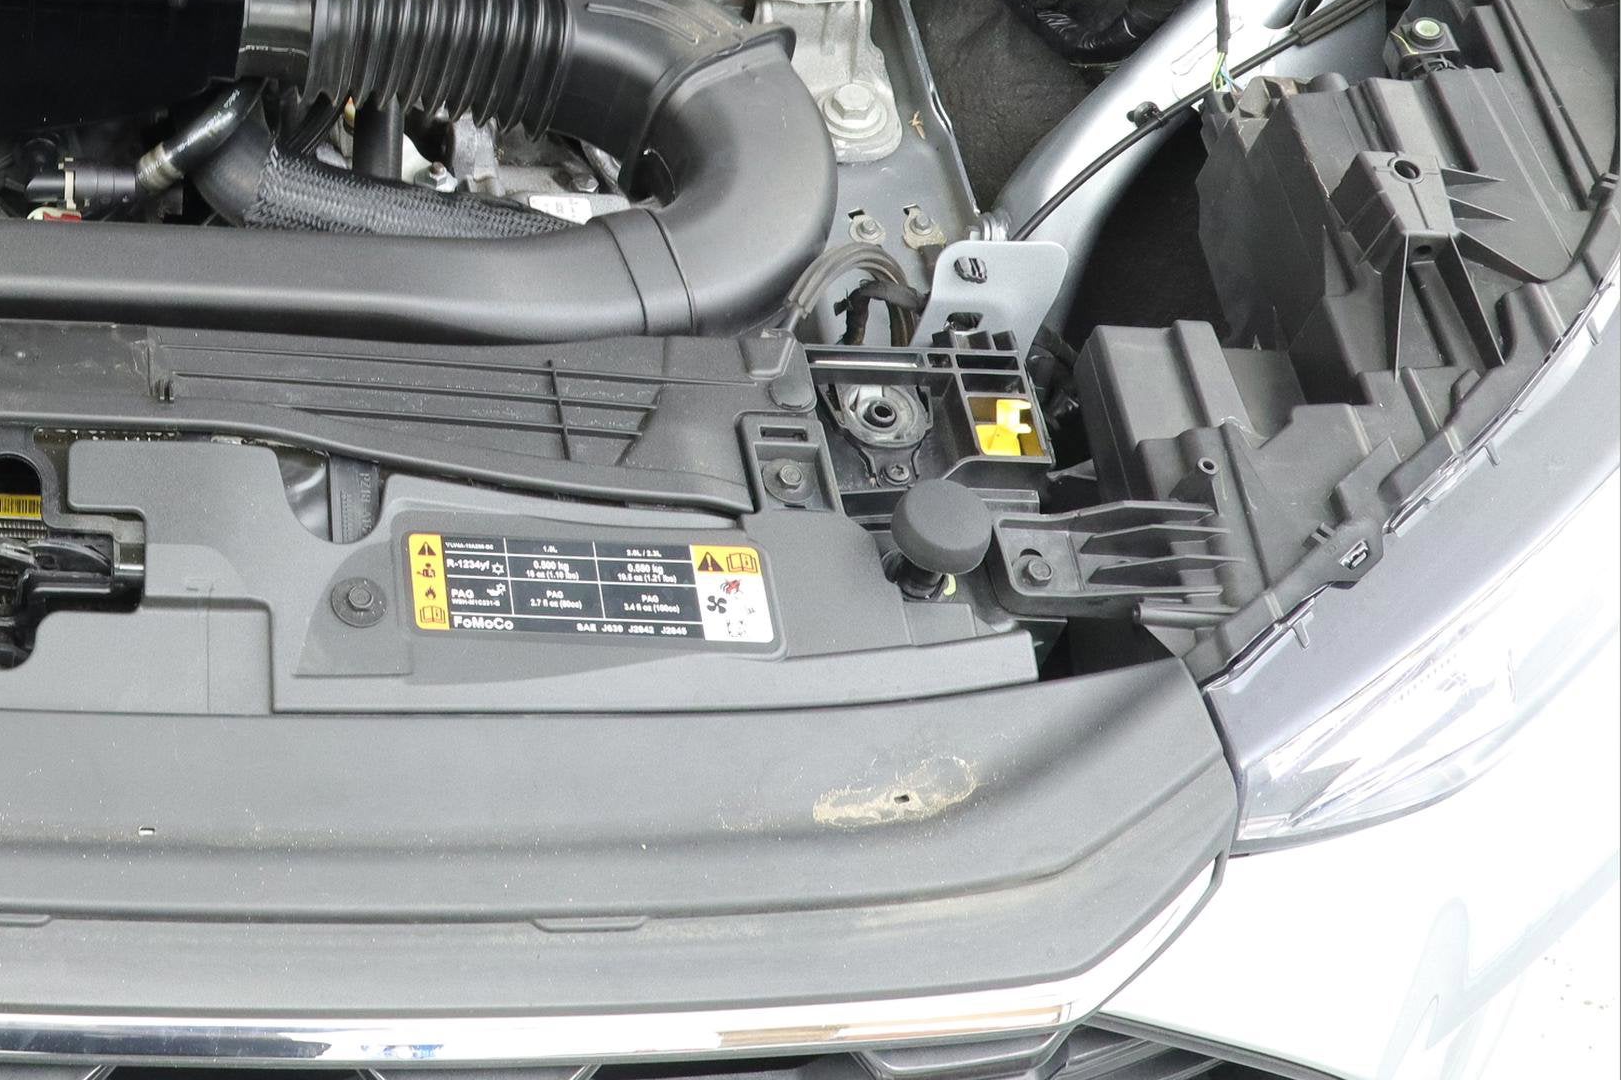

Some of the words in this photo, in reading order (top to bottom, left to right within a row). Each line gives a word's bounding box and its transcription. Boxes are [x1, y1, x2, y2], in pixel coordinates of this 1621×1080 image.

[446, 558, 491, 571] R-1234yf
[557, 560, 570, 573] kg
[651, 564, 664, 575] kg
[451, 588, 475, 599] PAG
[546, 590, 564, 599] PAG
[641, 594, 659, 603] PAG
[452, 615, 515, 631] FoMoCo
[576, 622, 598, 632] SAE
